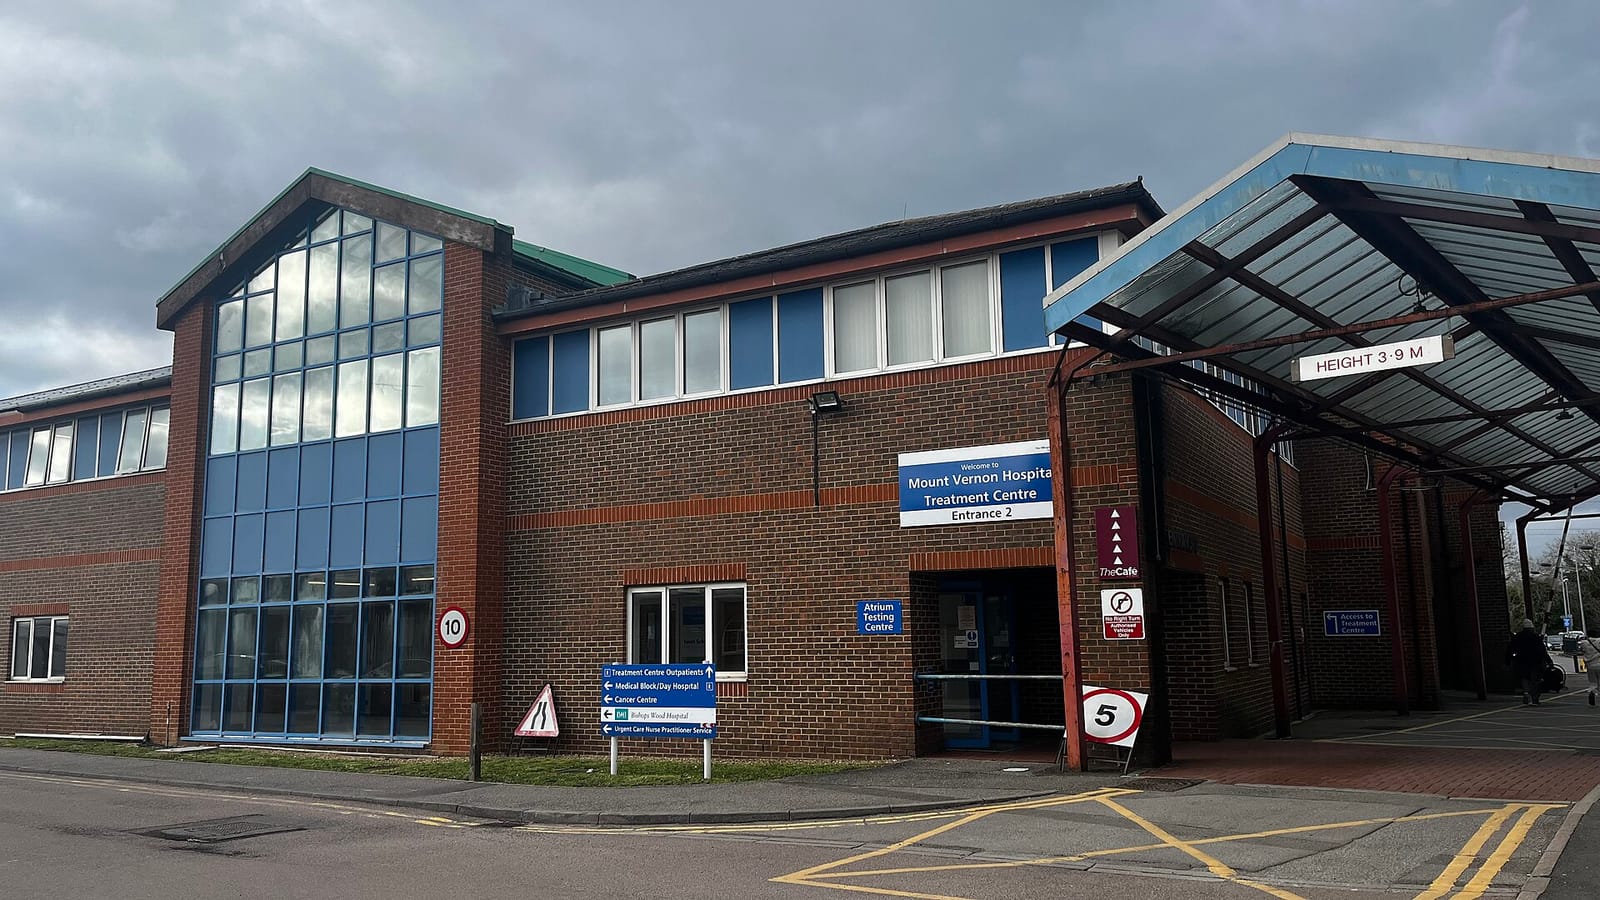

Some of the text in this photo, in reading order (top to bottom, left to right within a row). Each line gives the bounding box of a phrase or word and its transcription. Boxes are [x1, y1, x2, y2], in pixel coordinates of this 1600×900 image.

[1316, 353, 1373, 373] HEIGHT
[1410, 345, 1423, 359] M
[961, 463, 990, 471] Welcome
[908, 467, 1052, 489] Mount Vernon Hospita
[924, 489, 1037, 506] Treatment Centre
[951, 507, 1012, 521] Entrance 2
[863, 602, 894, 611] Atrium
[863, 613, 895, 623] Testing
[445, 619, 460, 635] 10
[864, 623, 894, 631] Centre
[665, 668, 704, 677] Outpatients
[615, 682, 639, 690] Medical
[640, 681, 671, 691] Block/Day
[672, 682, 699, 691] Hospital
[666, 712, 689, 720] Hospital
[1094, 704, 1118, 727] 5
[661, 726, 692, 734] Practitioner
